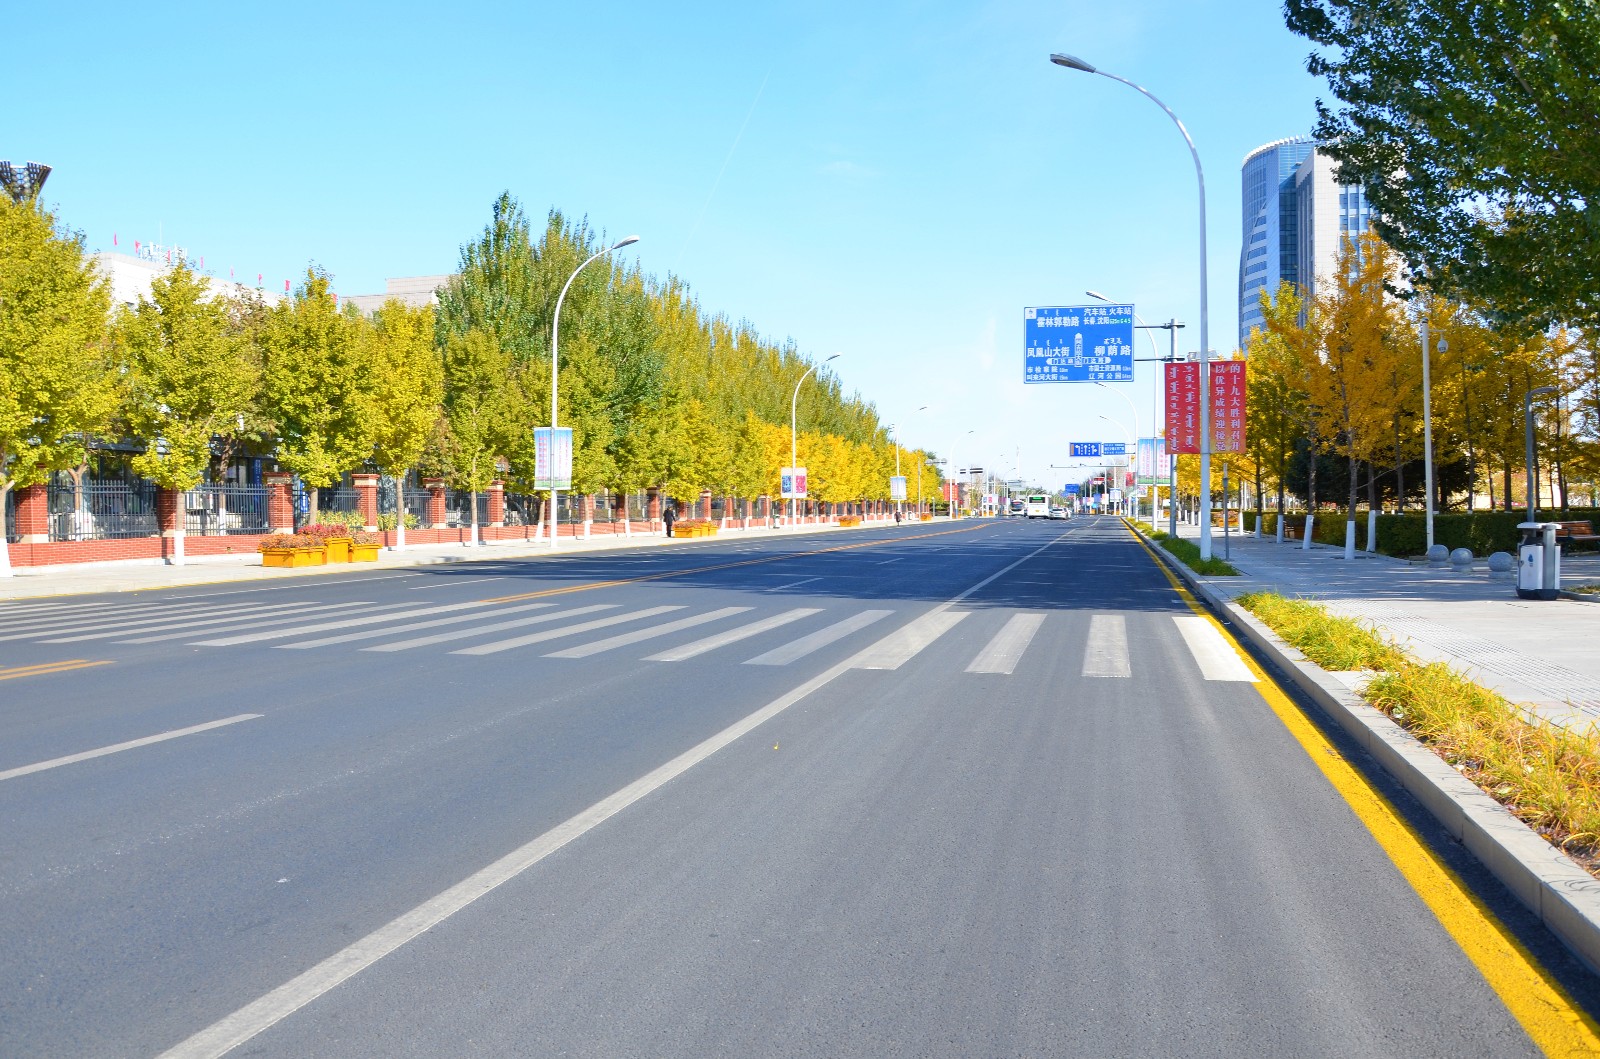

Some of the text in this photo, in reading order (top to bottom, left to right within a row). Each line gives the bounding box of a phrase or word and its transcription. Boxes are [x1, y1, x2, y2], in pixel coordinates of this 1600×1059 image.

[1037, 316, 1079, 327] 霍林郭勒路
[1027, 346, 1070, 358] 凤凰山大街
[1094, 345, 1131, 356] 柳荫路
[1215, 365, 1226, 451] 以优异成绩迎接党
[1229, 363, 1241, 451] 的十九大胜利召开
